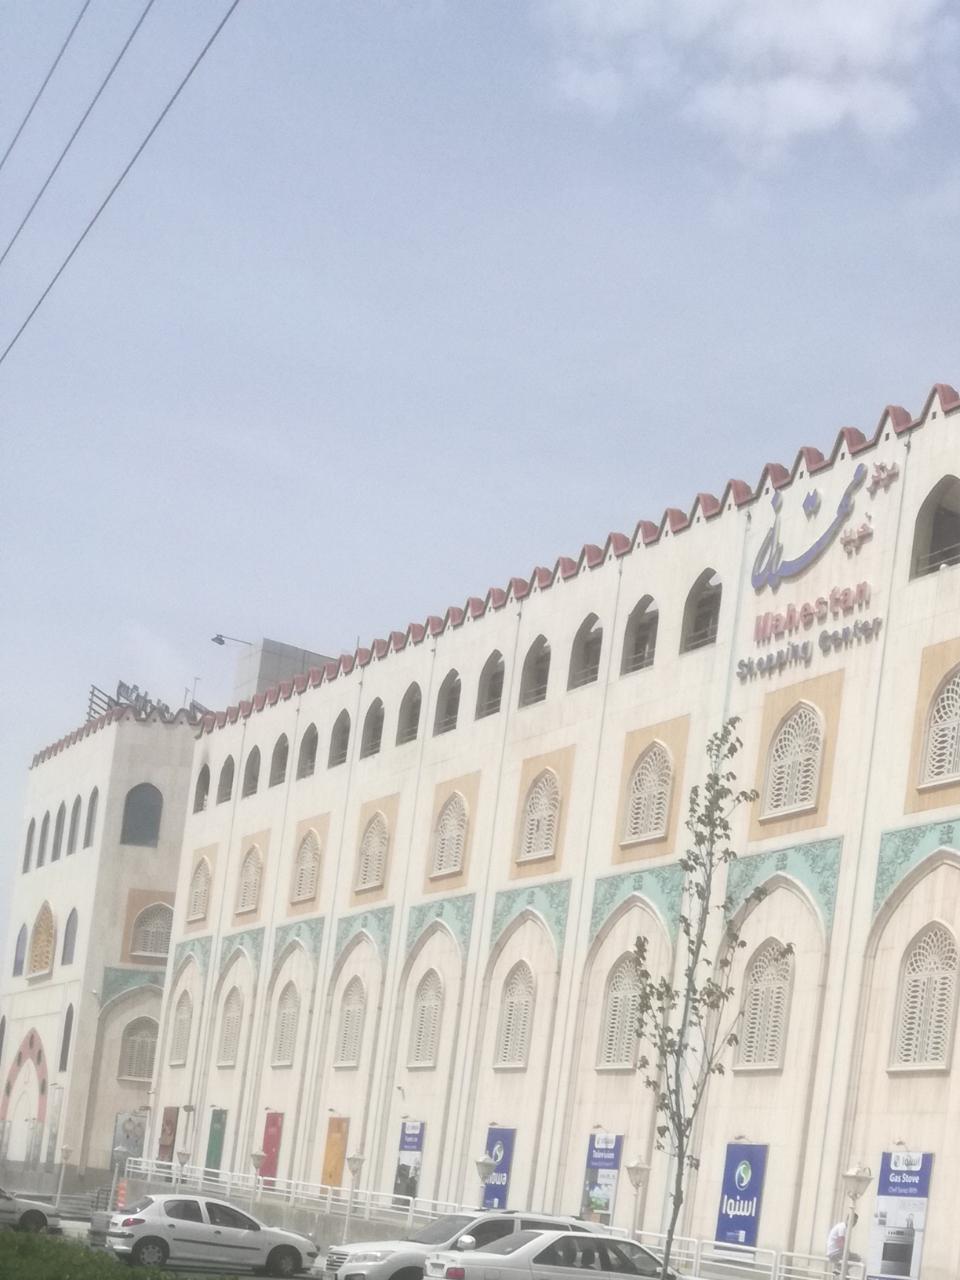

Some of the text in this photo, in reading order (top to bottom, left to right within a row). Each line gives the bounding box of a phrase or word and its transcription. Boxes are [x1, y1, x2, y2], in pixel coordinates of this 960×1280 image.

[754, 581, 871, 646] Mahestan
[736, 617, 883, 684] Shopping Center
[889, 1173, 920, 1184] Gas Stove
[722, 1195, 757, 1218] اسنوا
